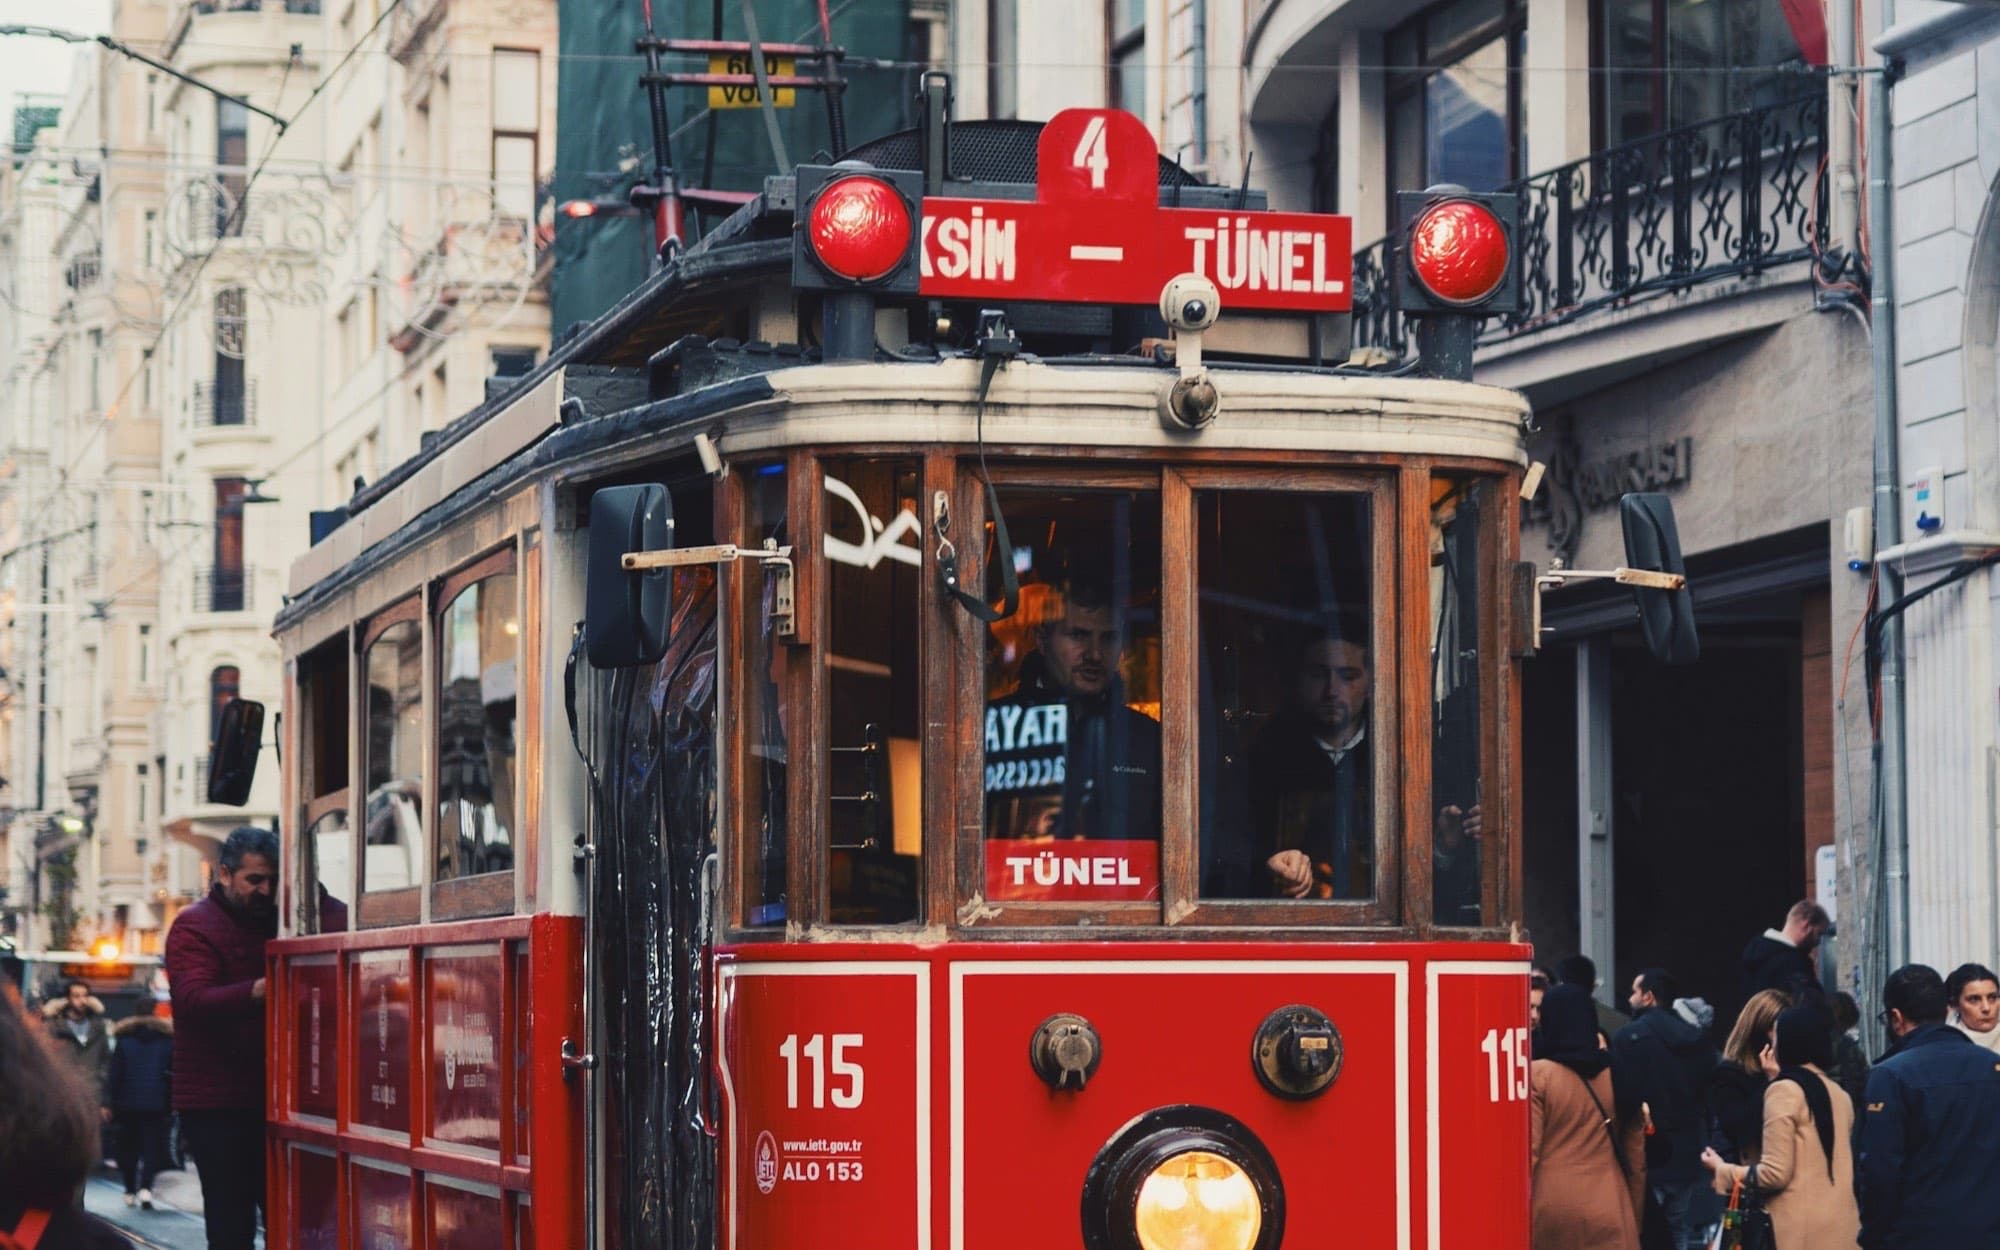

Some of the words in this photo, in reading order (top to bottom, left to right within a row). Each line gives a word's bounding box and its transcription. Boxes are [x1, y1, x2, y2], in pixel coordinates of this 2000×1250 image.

[1073, 117, 1109, 189] 4
[1185, 217, 1343, 293] TÜNEL
[1006, 852, 1141, 886] TÜNEL
[779, 1033, 864, 1109] 115
[1481, 1027, 1529, 1103] 115
[783, 1139, 862, 1154] www.iett.gov.tr
[783, 1162, 820, 1181] ALO
[826, 1162, 863, 1181] 153
